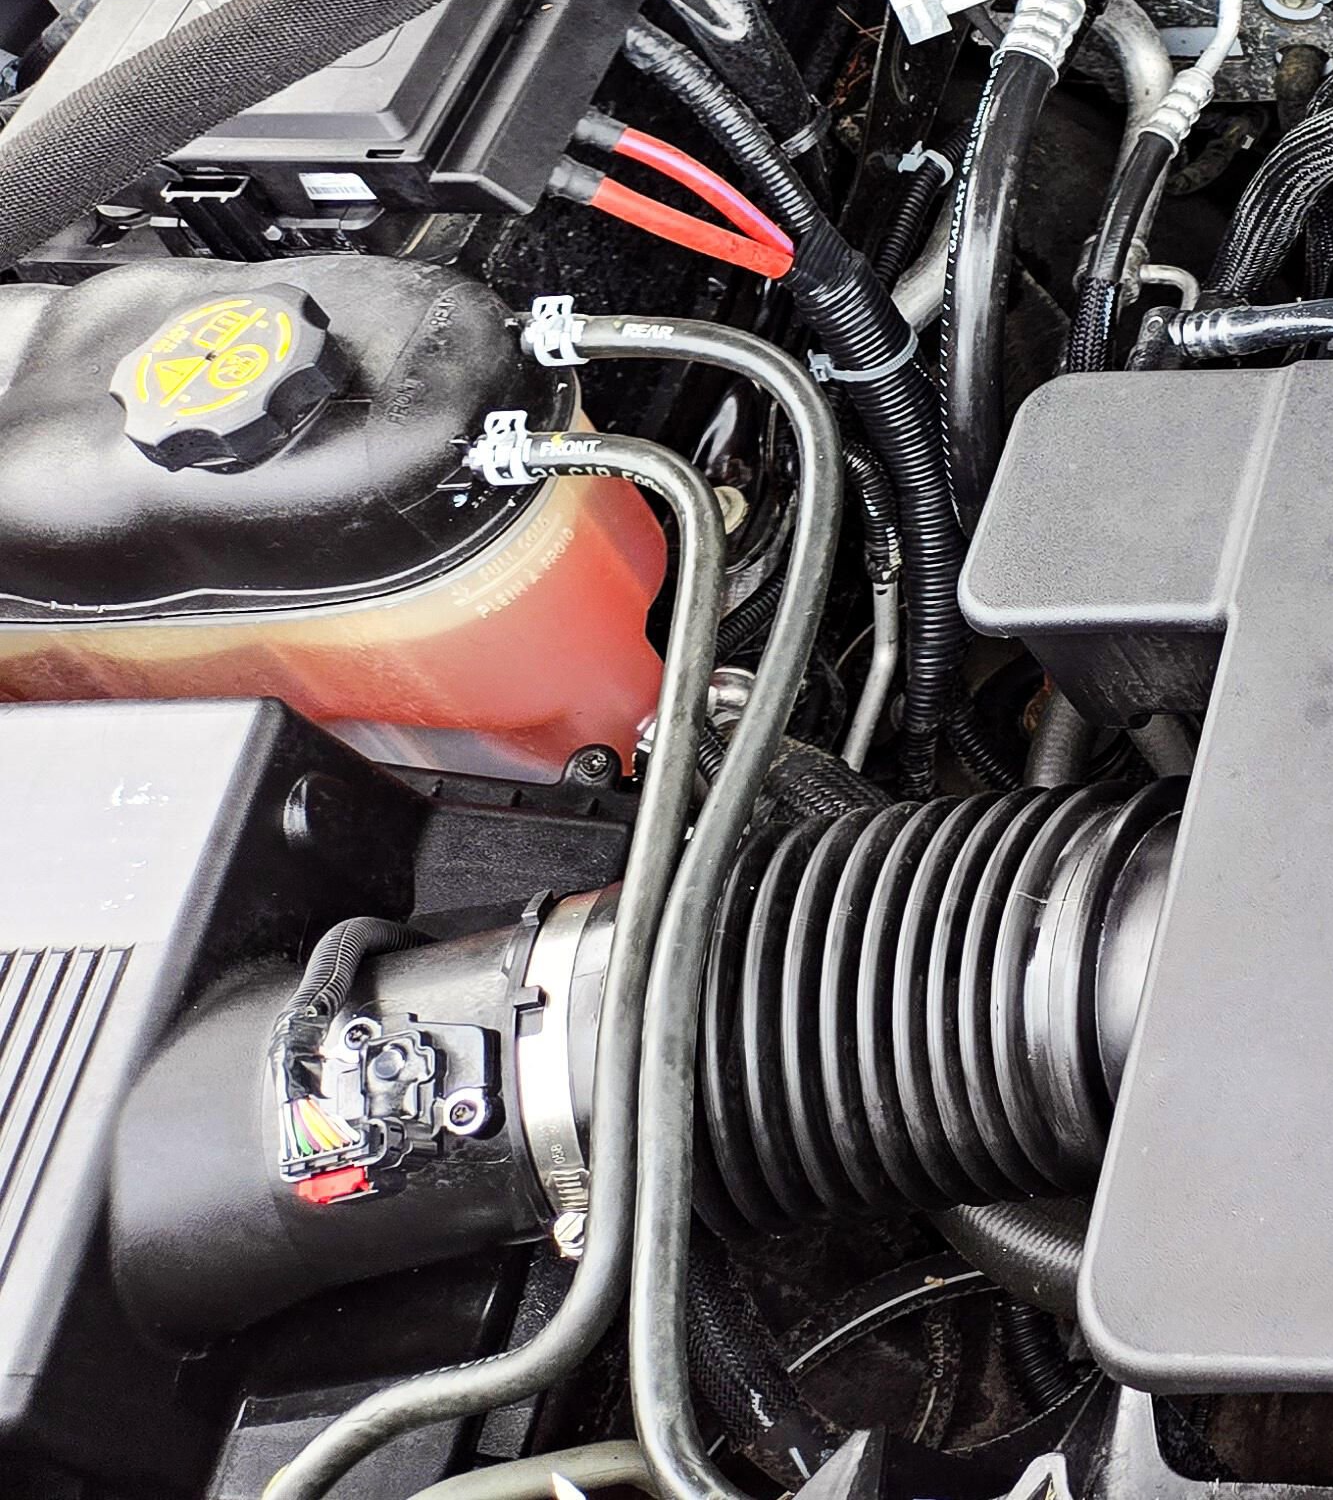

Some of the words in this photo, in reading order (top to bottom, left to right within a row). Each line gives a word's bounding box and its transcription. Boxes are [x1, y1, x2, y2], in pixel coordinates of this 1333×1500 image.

[949, 179, 967, 253] GALAXY
[621, 322, 675, 340] REAR
[539, 439, 602, 458] FRONT
